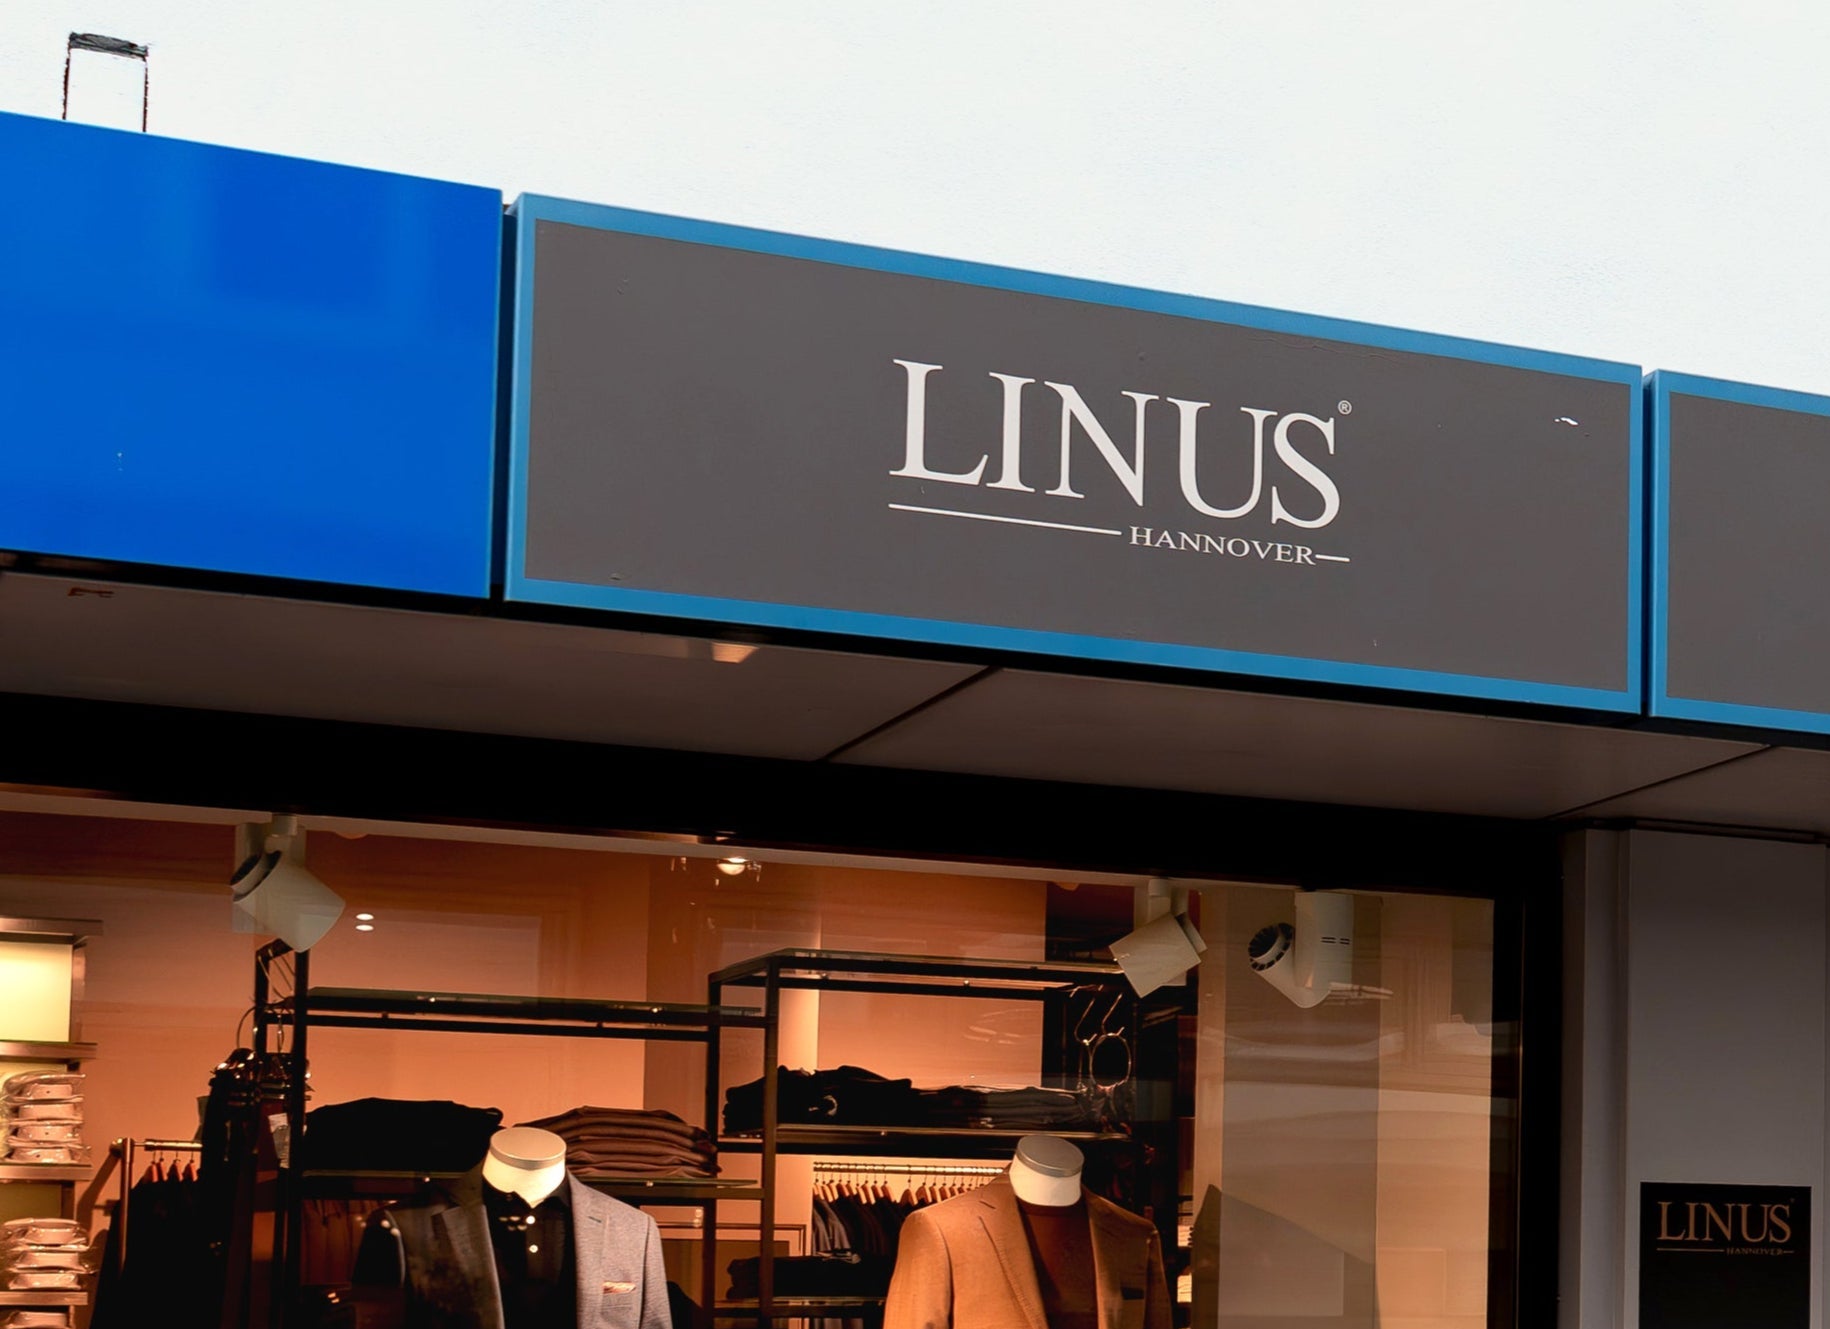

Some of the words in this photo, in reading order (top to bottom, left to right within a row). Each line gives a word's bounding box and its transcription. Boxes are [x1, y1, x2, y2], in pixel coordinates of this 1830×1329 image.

[889, 358, 1341, 529] LINUS
[1129, 525, 1316, 566] HANNOVER
[1656, 1201, 1792, 1243] LINUS
